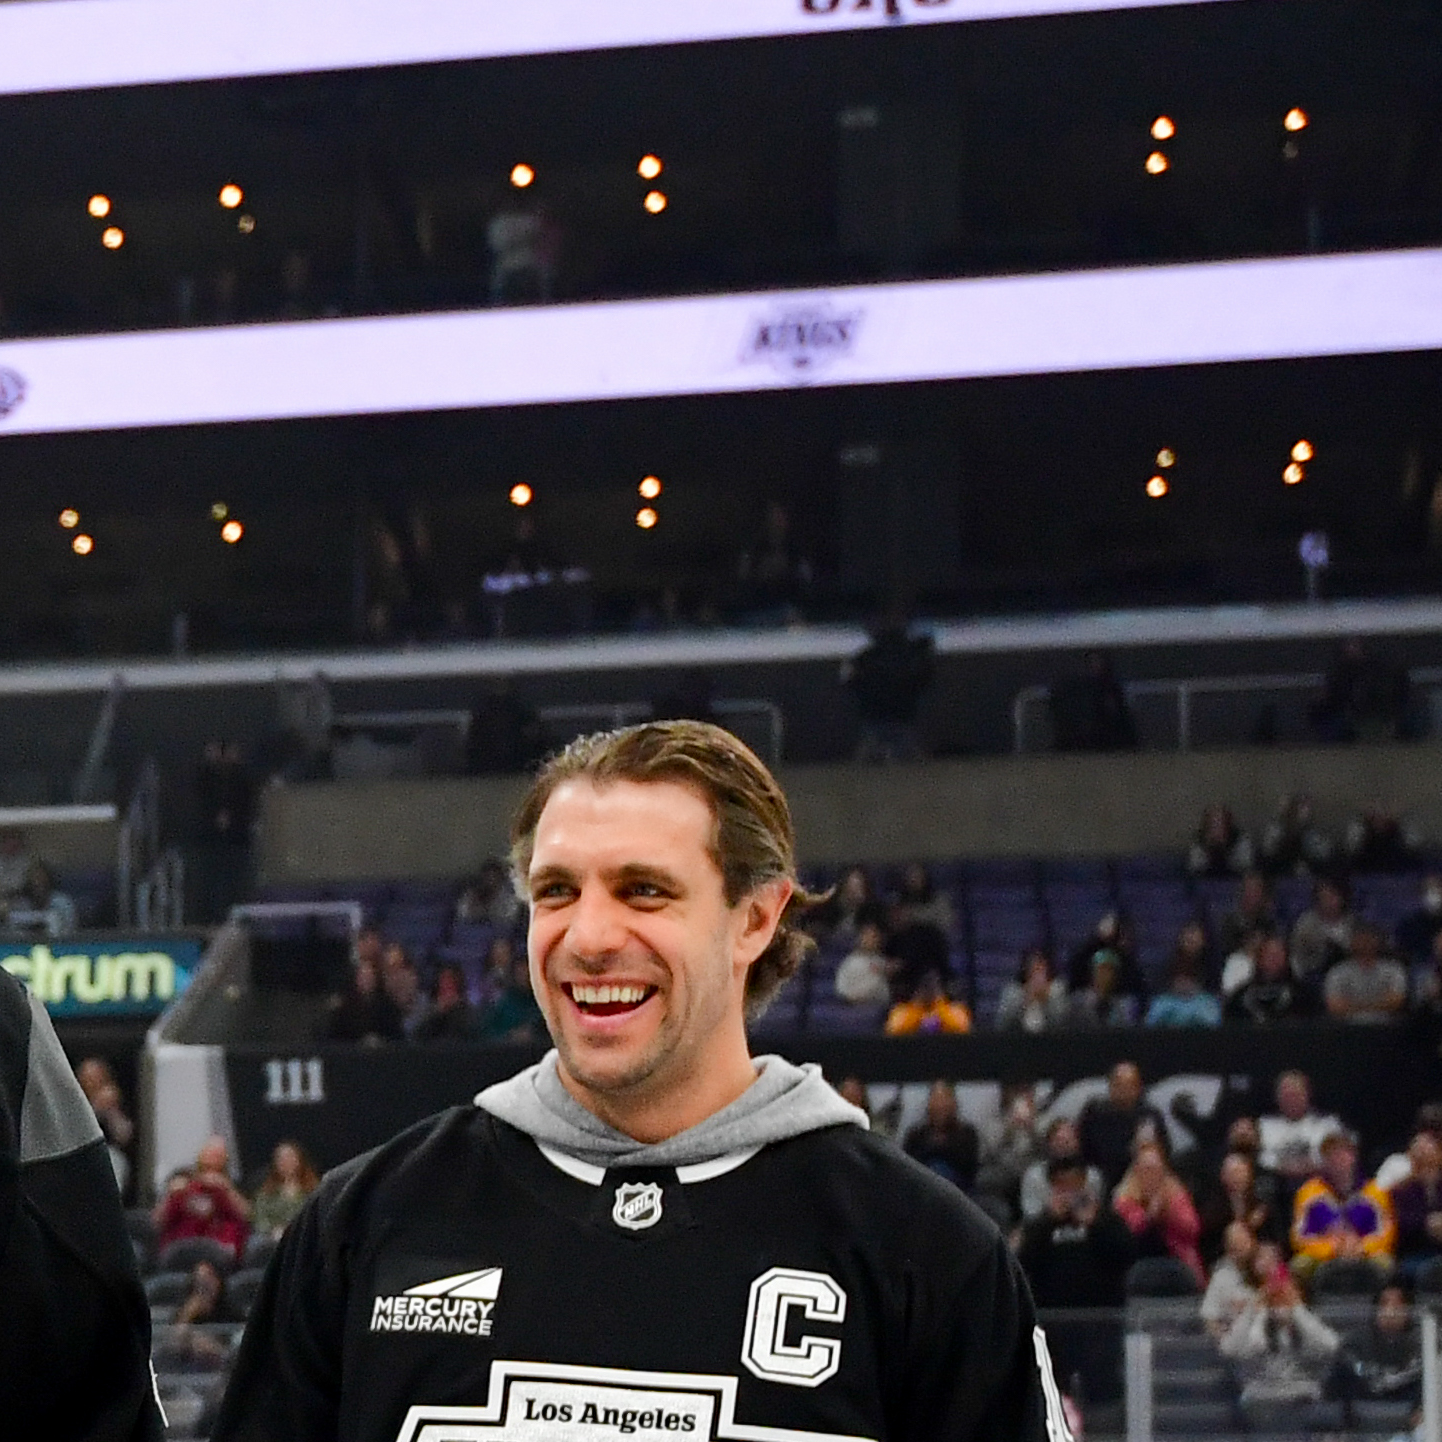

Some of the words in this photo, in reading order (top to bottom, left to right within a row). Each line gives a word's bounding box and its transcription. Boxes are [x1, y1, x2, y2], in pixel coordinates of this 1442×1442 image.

[266, 1058, 324, 1103] 111
[370, 1313, 494, 1337] INSURANCE
[374, 1296, 496, 1319] MERCURY
[741, 1266, 847, 1388] C
[523, 1397, 573, 1423] Los
[579, 1401, 697, 1434] Angeles
